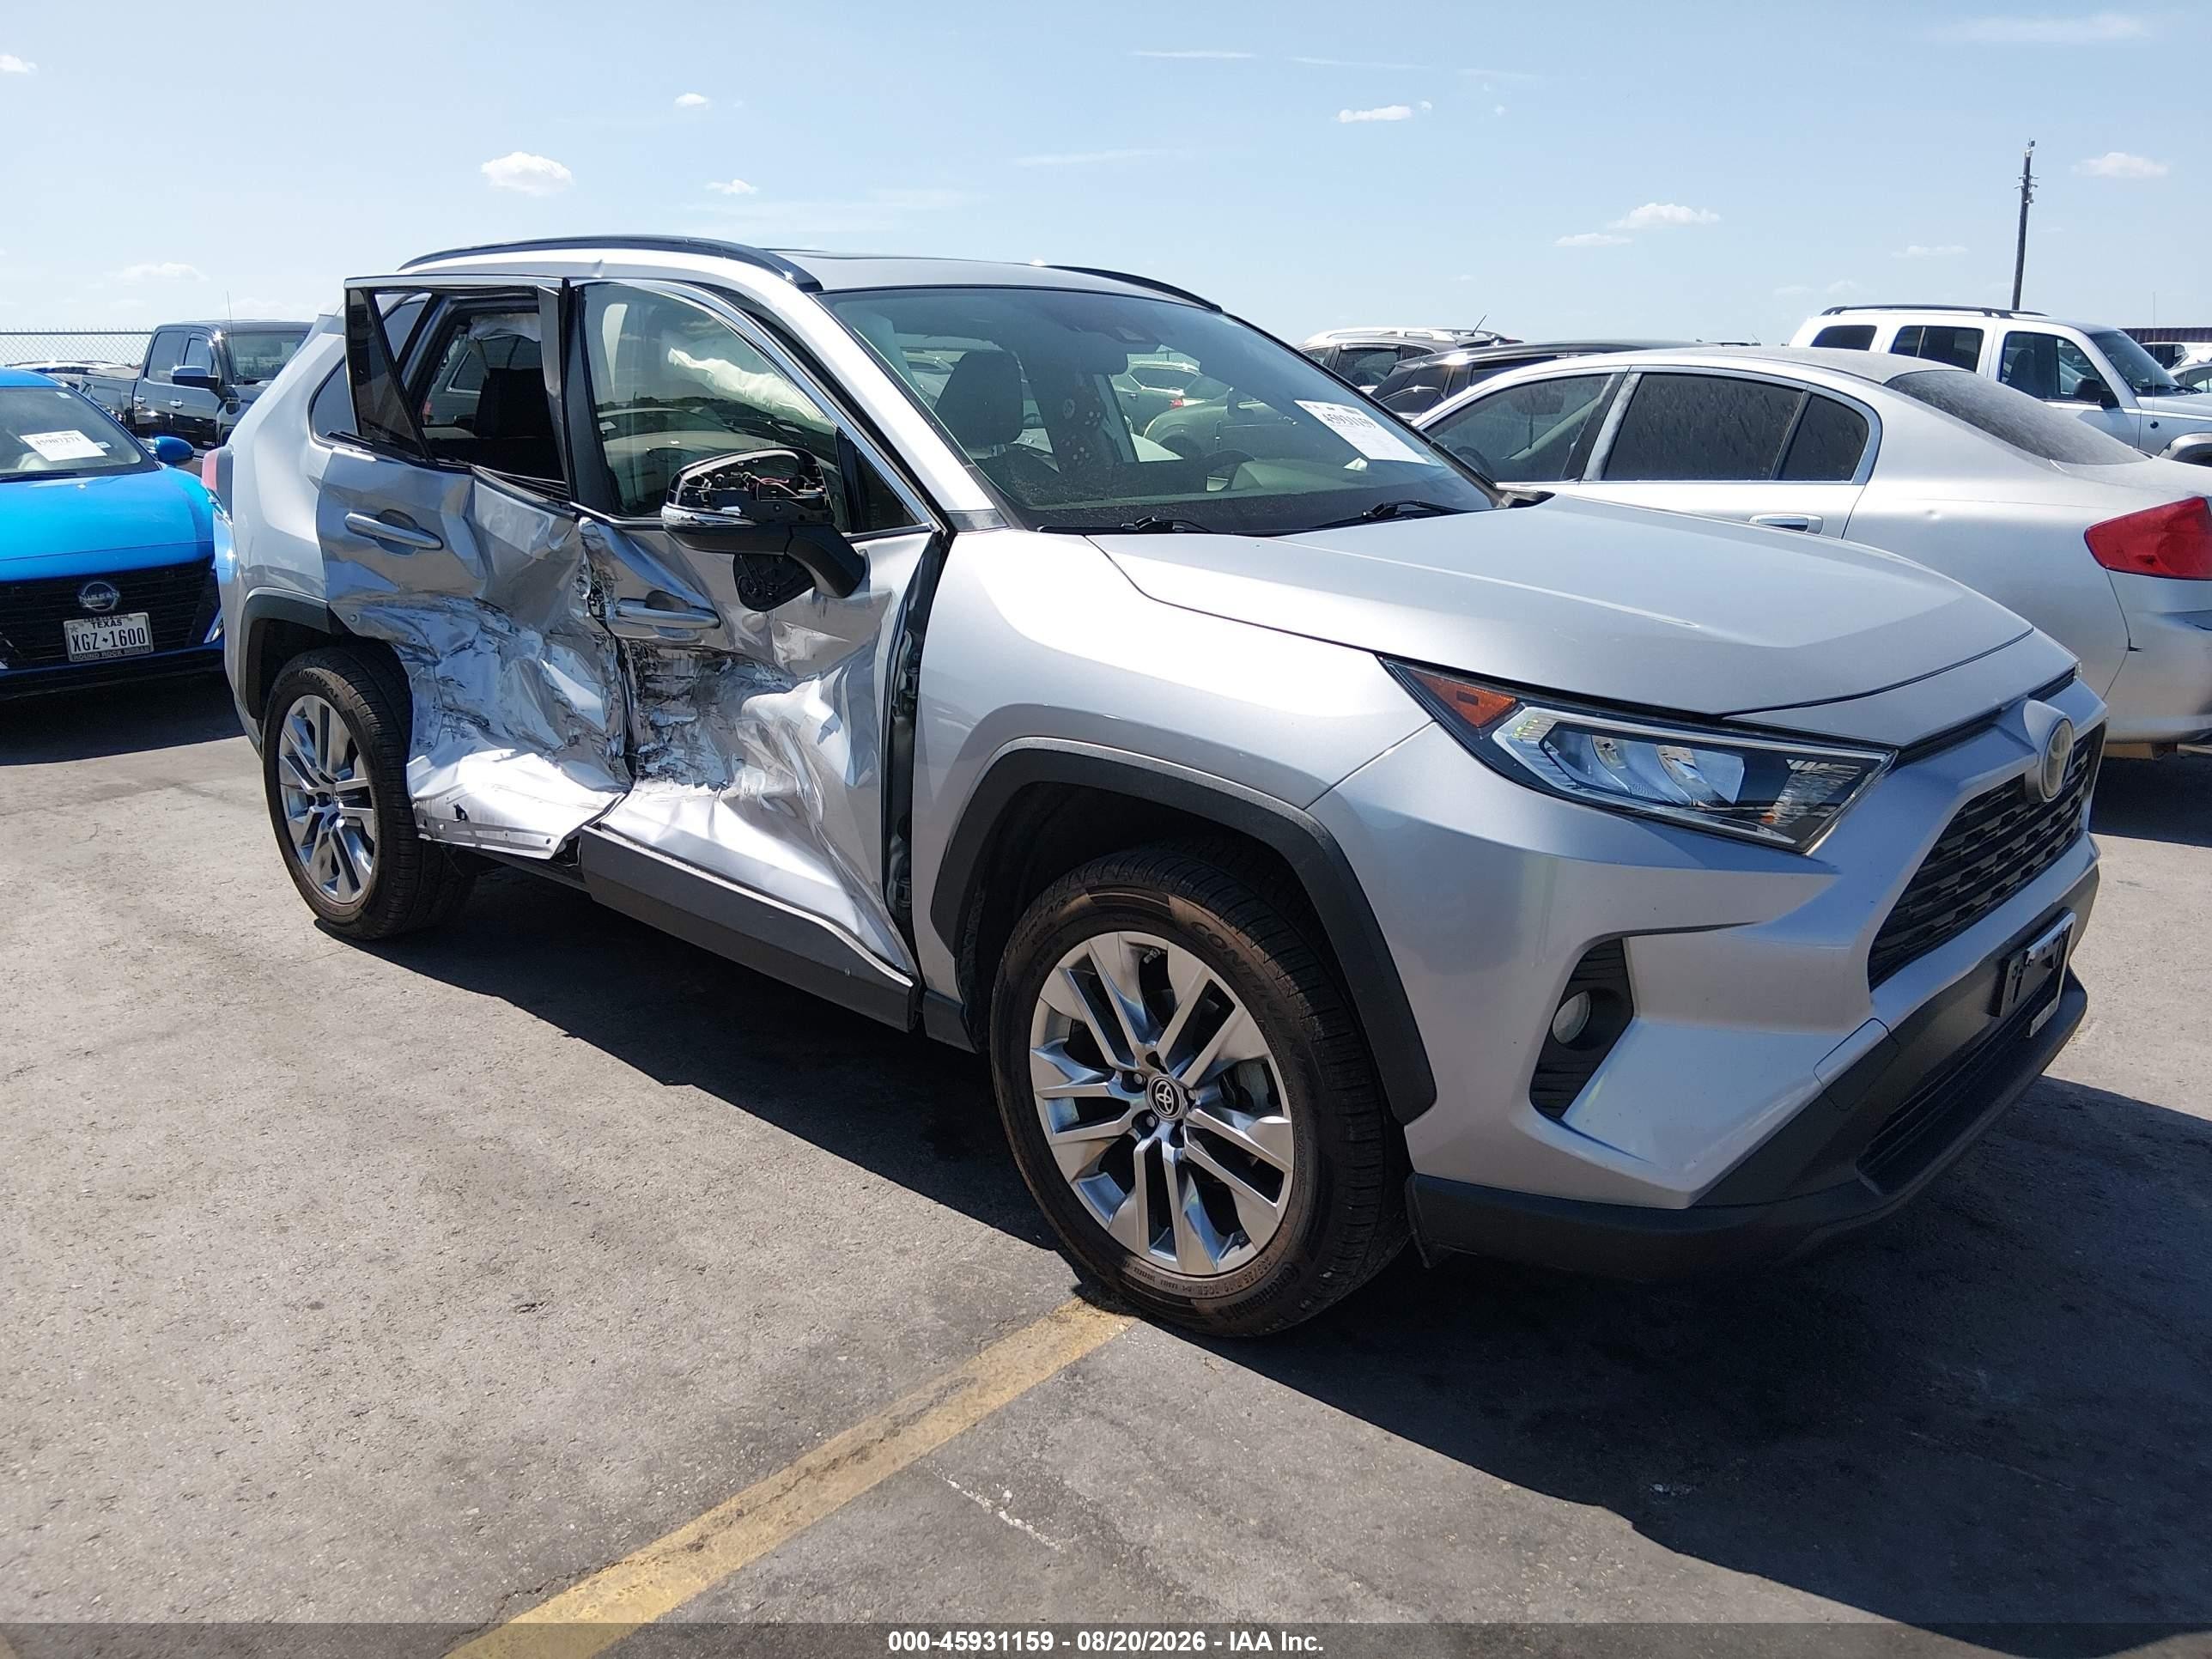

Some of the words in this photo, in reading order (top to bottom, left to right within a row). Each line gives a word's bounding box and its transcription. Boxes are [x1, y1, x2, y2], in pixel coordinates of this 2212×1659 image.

[91, 619, 123, 629] TEXAS
[71, 632, 100, 653] XGZ
[109, 627, 146, 647] 1600
